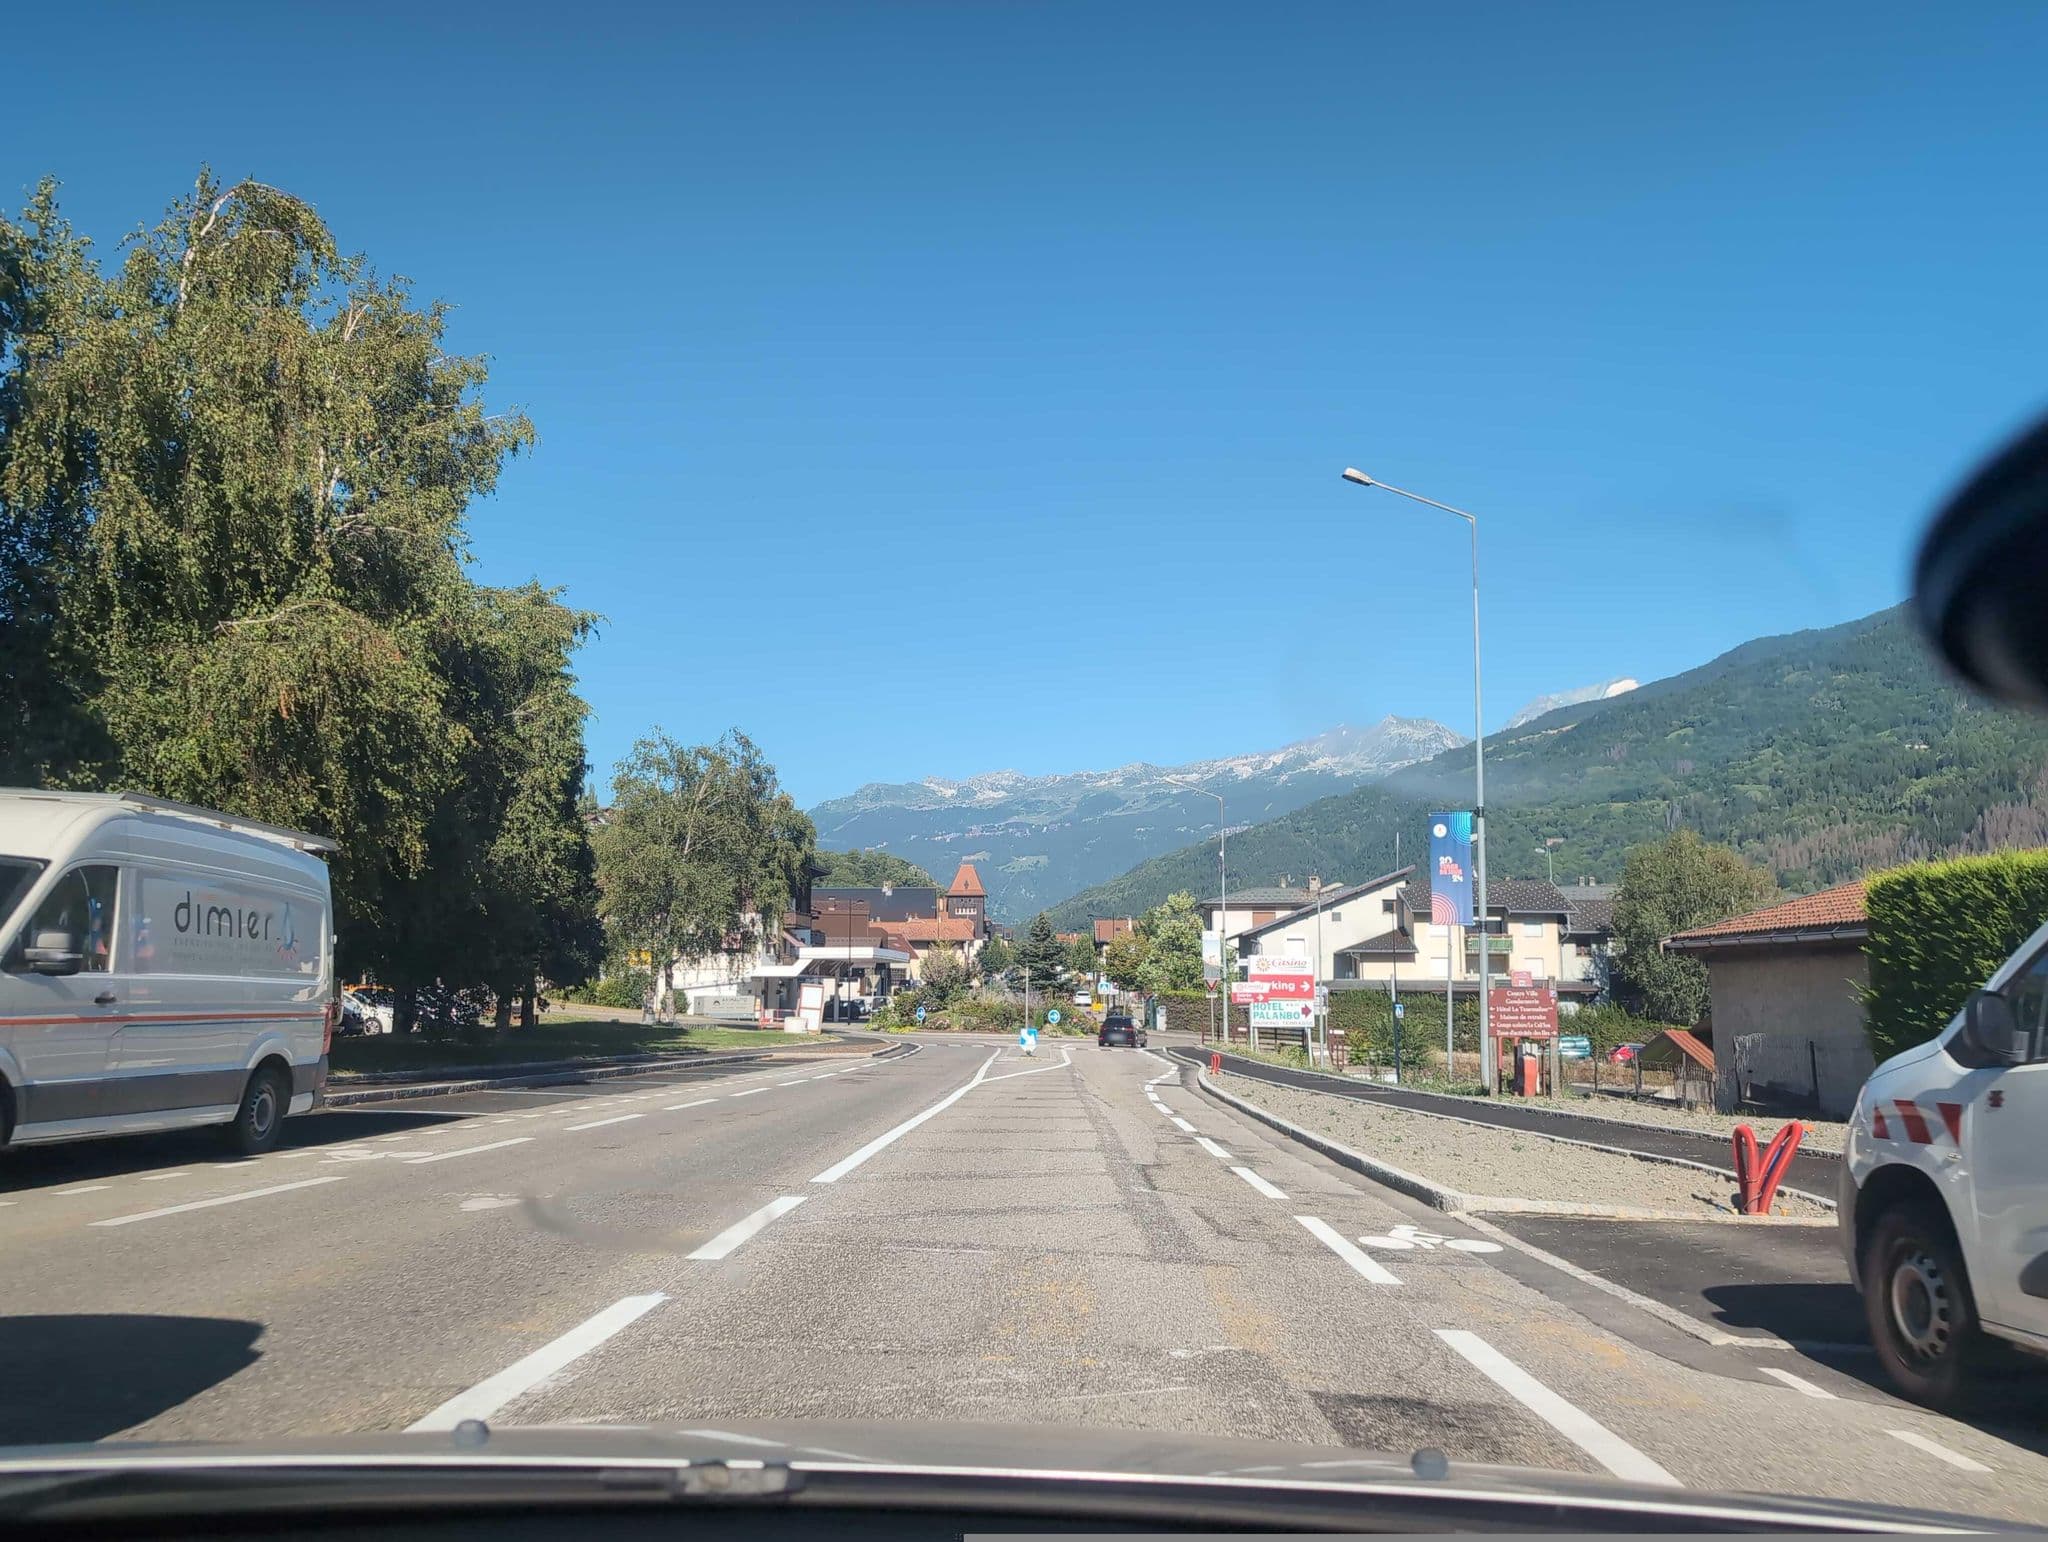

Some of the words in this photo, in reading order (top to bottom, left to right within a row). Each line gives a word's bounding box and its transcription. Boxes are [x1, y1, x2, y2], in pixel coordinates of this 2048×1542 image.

[174, 890, 274, 941] dimier
[1271, 959, 1307, 968] Casino
[1253, 1002, 1284, 1011] HOTEL
[1253, 1011, 1301, 1020] PALANBO
